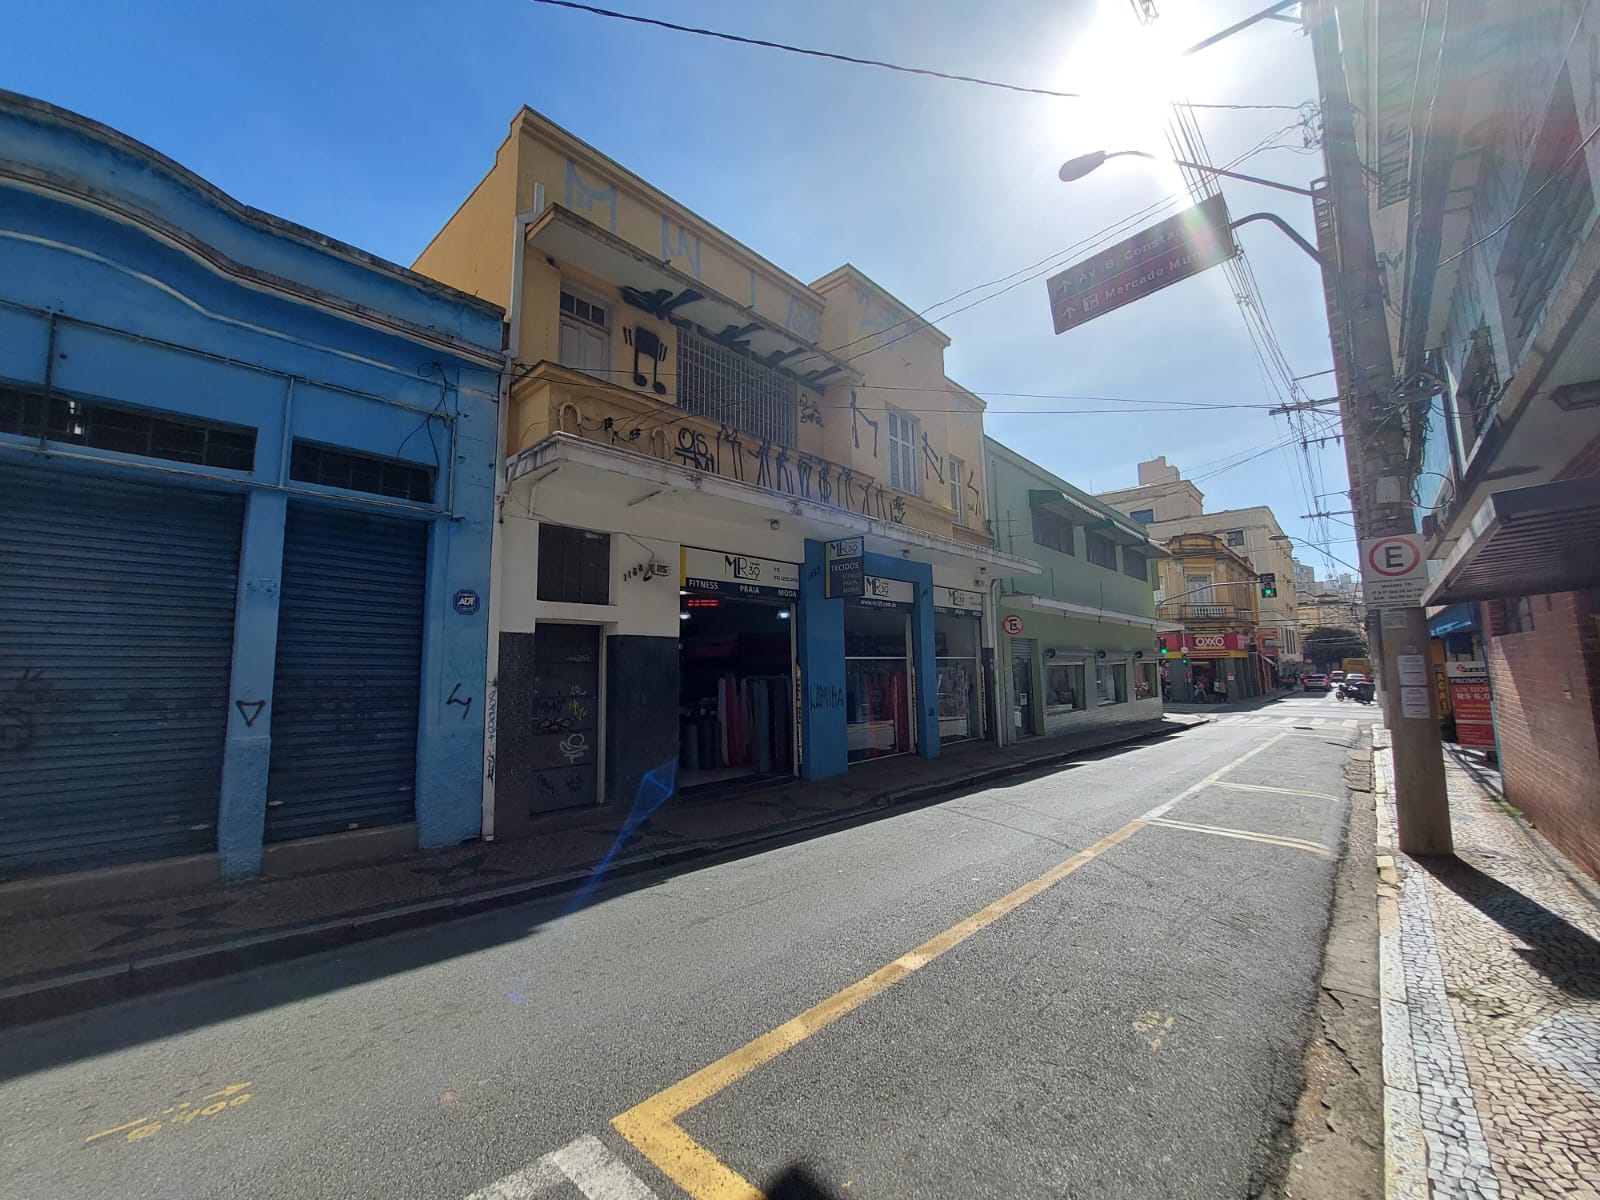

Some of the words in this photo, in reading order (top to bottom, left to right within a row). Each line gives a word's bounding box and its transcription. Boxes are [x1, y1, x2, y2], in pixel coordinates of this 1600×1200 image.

[1124, 226, 1186, 260] Constan
[1105, 267, 1165, 300] Mercado
[1385, 545, 1404, 568] E
[831, 561, 860, 573] TECIDOS
[688, 579, 719, 590] FITNESS
[739, 584, 760, 595] PRAIA
[778, 589, 797, 598] MODA
[458, 597, 476, 606] ADT
[1195, 636, 1225, 649] OXXO
